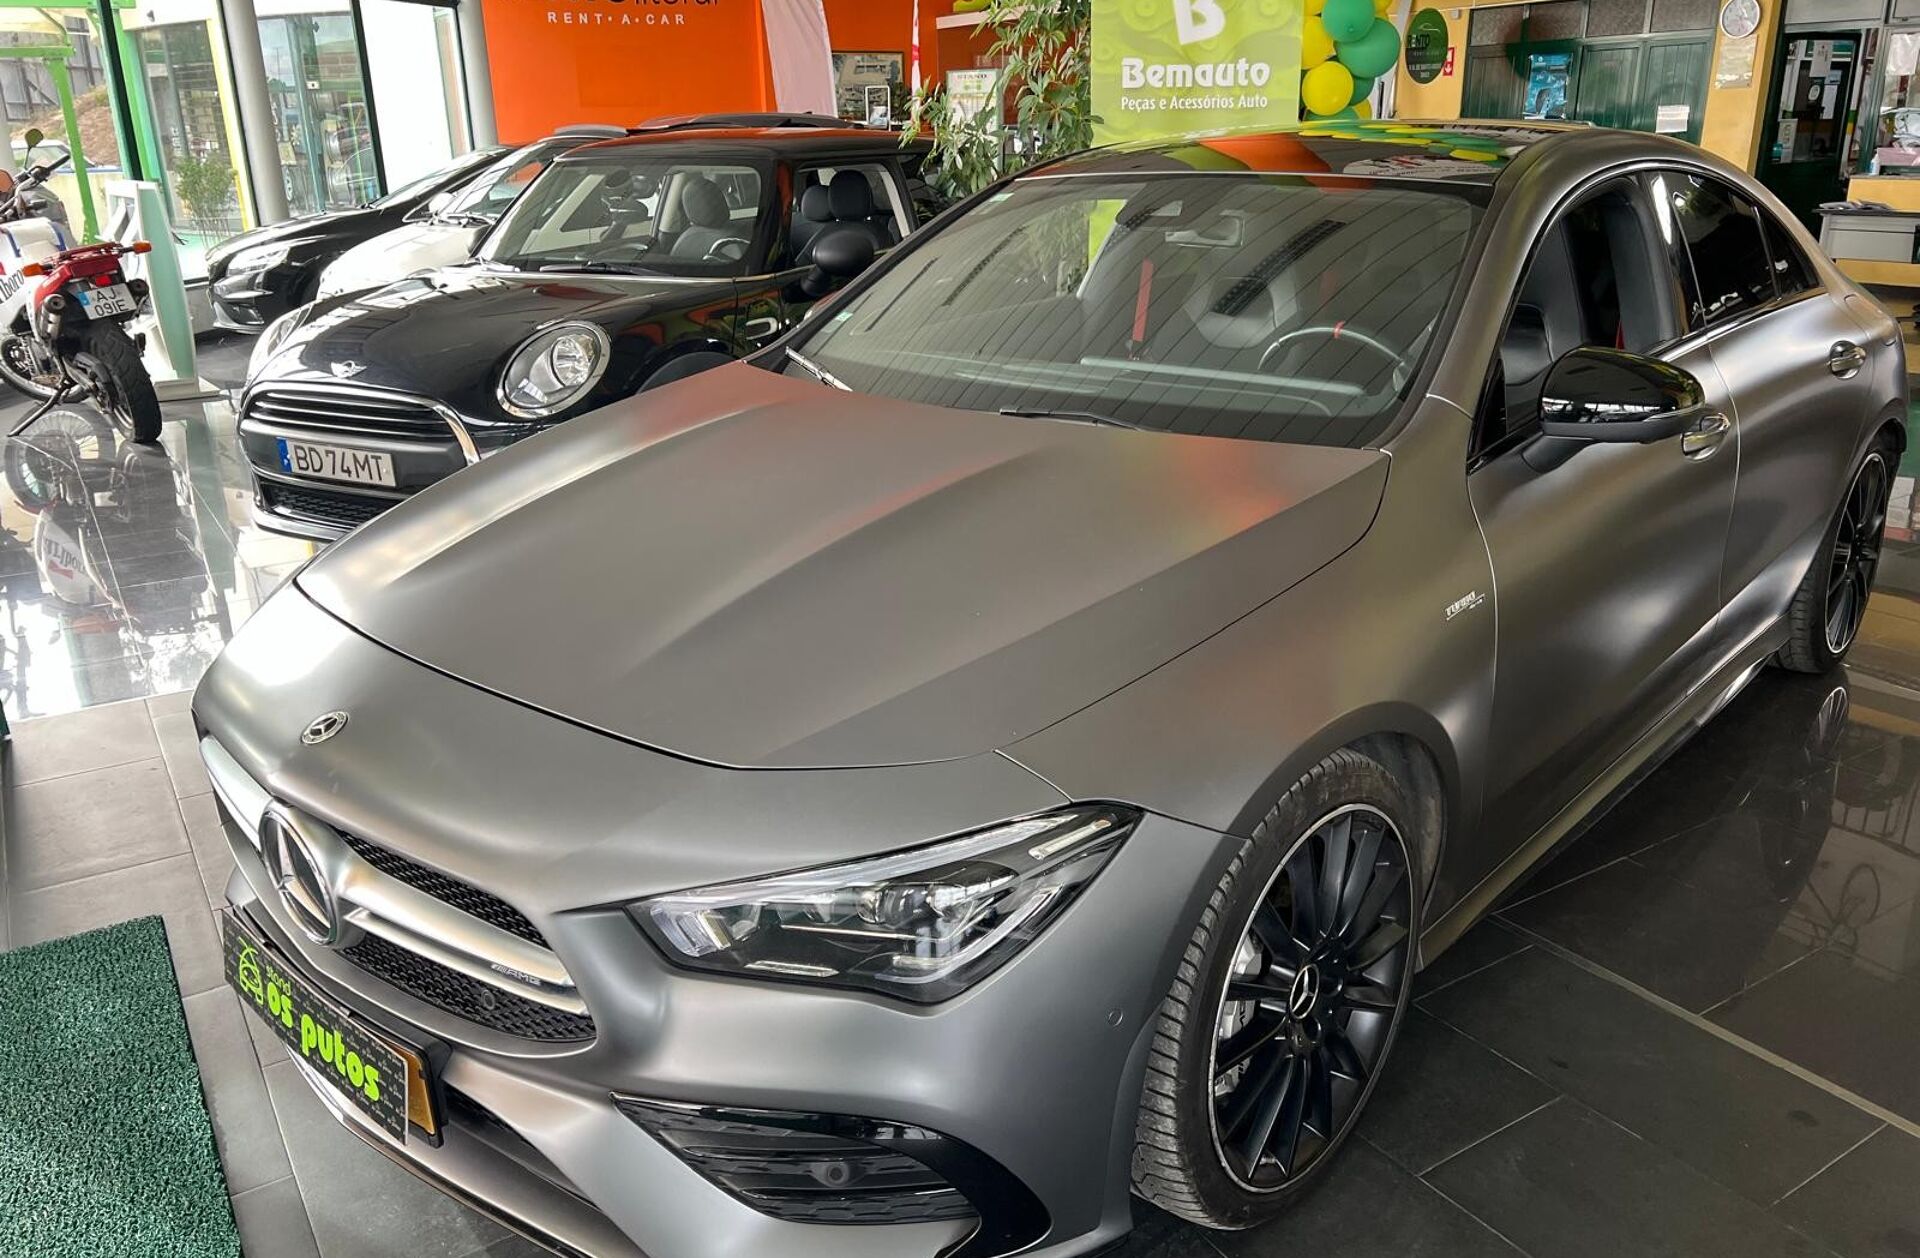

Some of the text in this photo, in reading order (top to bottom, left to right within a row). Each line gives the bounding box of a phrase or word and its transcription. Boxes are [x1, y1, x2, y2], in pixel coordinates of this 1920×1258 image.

[1121, 57, 1271, 89] Bemauto
[1121, 94, 1268, 112] Peças e Acessórios Auto
[96, 287, 117, 302] AJ
[301, 1013, 380, 1102] putos
